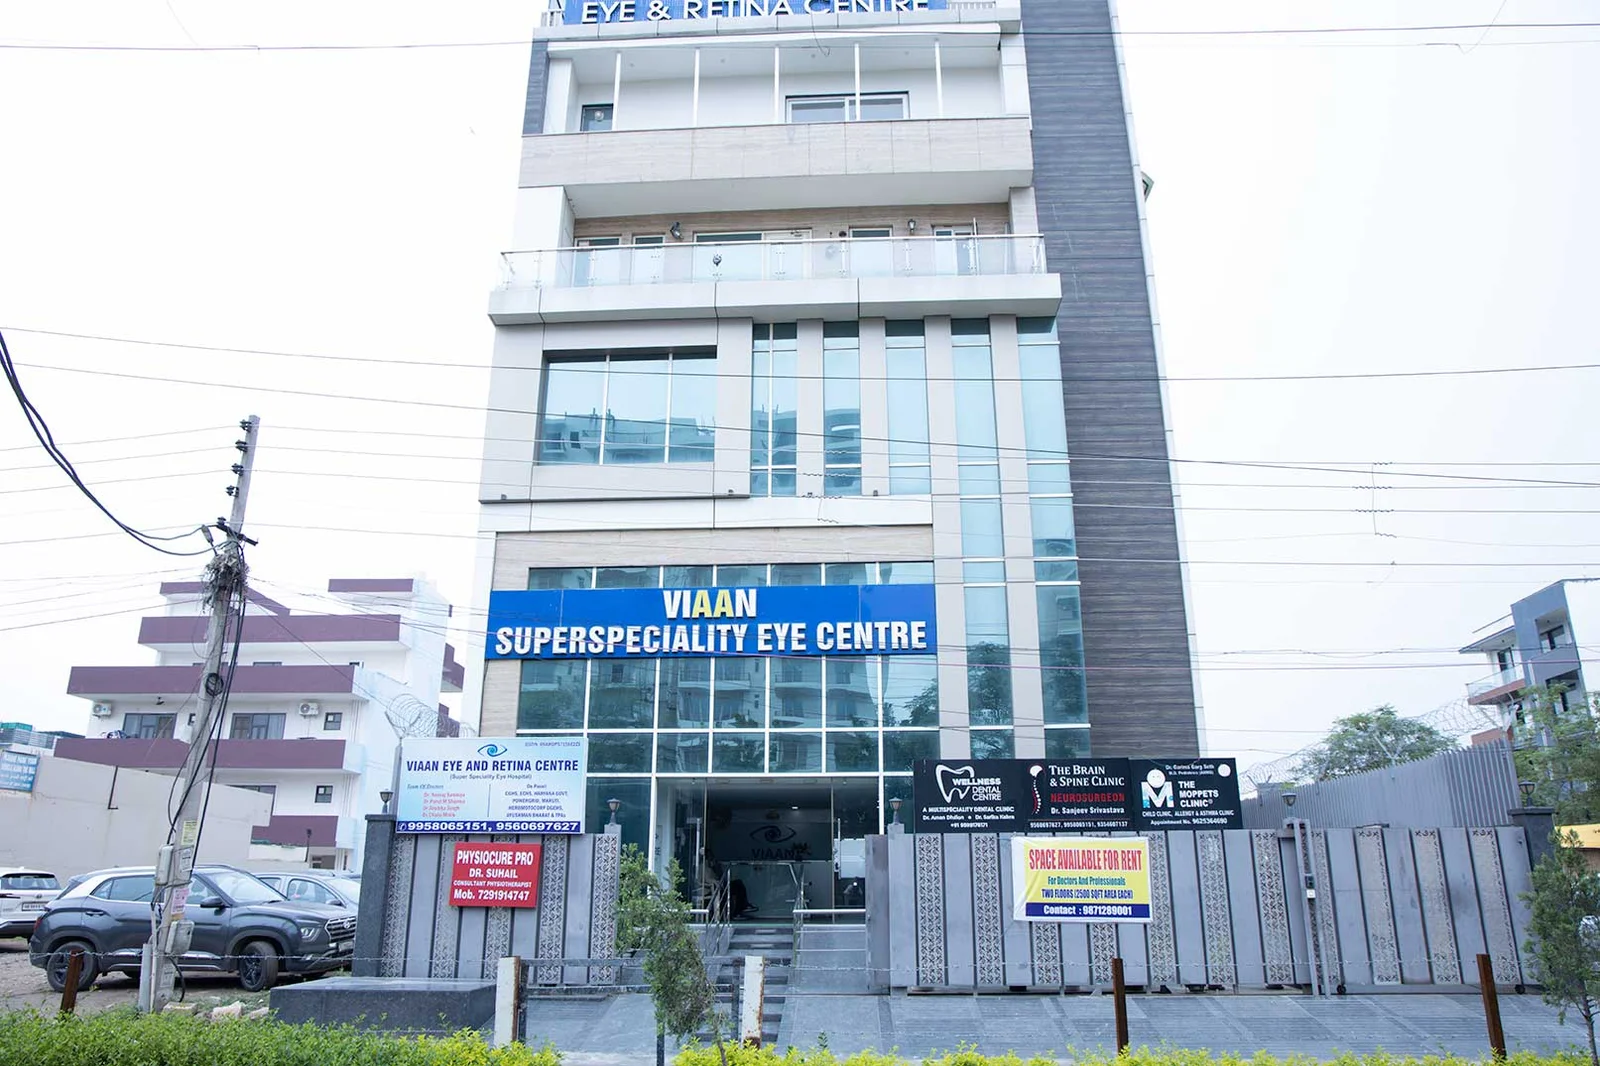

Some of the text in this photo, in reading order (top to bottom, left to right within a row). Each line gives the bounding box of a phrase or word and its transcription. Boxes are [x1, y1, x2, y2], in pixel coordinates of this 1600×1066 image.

[581, 0, 929, 24] EYE & RETINA CENTRE
[663, 590, 757, 618] VIAAN
[495, 621, 928, 656] SUPERSPECIALITY EYE CENTRE
[407, 760, 578, 771] VIAAN EYE AND RETINA CENTRE
[1049, 778, 1058, 786] &
[1178, 781, 1195, 789] THE
[972, 793, 1002, 801] CENTRE
[1051, 793, 1125, 802] NEUROSURGEON
[1179, 790, 1219, 798] MOPPETS
[1062, 807, 1088, 815] Sanjeev
[1090, 806, 1125, 814] Srivastava
[407, 822, 578, 832] 9958065151, 9560697627
[456, 850, 534, 866] PHYSIOCURE PRO
[1029, 849, 1142, 871] SPACE AVAILABLE FOR RENT
[469, 868, 518, 879] DR. SUHAIL
[1048, 876, 1126, 886] For Doctors And Professionals
[453, 889, 530, 901] Mob. 7291914747
[1041, 888, 1054, 899] TWO
[1054, 889, 1074, 899] FLOORS
[1104, 889, 1117, 899] AREA
[1043, 905, 1076, 915] Contact
